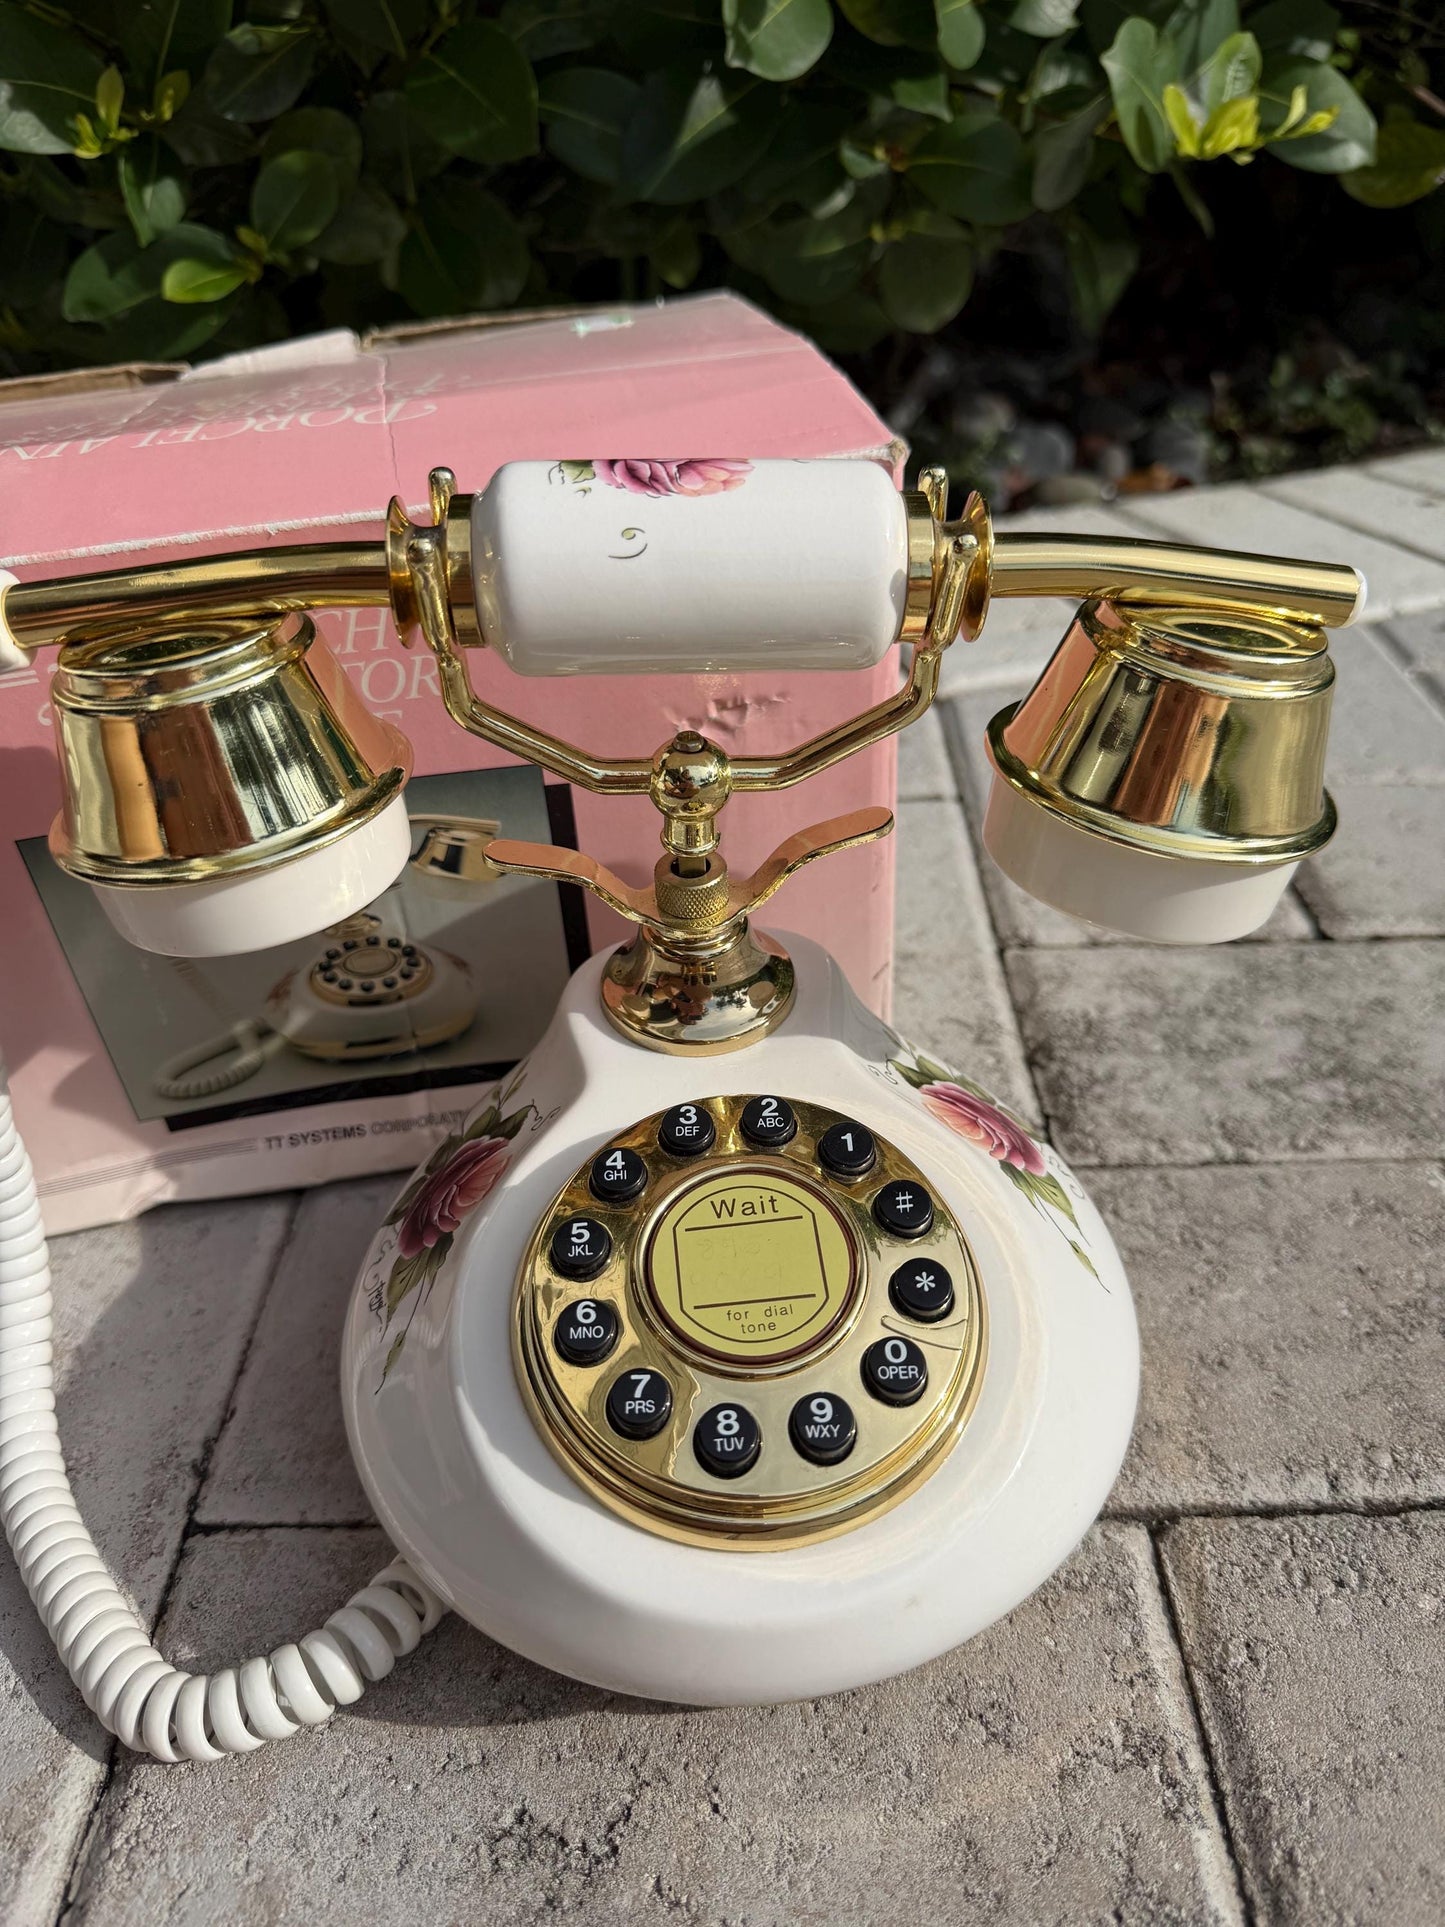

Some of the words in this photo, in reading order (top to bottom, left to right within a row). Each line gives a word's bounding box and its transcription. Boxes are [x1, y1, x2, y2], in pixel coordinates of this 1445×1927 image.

[679, 1104, 698, 1125] 3
[761, 1097, 779, 1118] 2
[674, 1125, 701, 1138] DEF
[756, 1117, 785, 1129] ABC
[264, 1136, 285, 1150] TT
[288, 1123, 367, 1147] SYSTEMS
[840, 1132, 855, 1152] 1
[605, 1150, 626, 1171] 4
[603, 1170, 628, 1182] GHI
[709, 1195, 779, 1219] Wait
[894, 1190, 914, 1213] #
[570, 1222, 591, 1245] 5
[567, 1244, 594, 1258] JKL
[576, 1301, 597, 1324] 6
[726, 1309, 750, 1321] for
[764, 1303, 794, 1317] dial
[568, 1324, 605, 1339] MNO
[741, 1321, 777, 1334] tone
[884, 1340, 908, 1364] 0
[877, 1365, 919, 1381] OPER
[630, 1374, 652, 1398] 7
[624, 1400, 656, 1415] PRS
[810, 1397, 833, 1423] 9
[716, 1409, 740, 1436] 8
[804, 1424, 841, 1440] WXY
[713, 1437, 745, 1452] TUV
